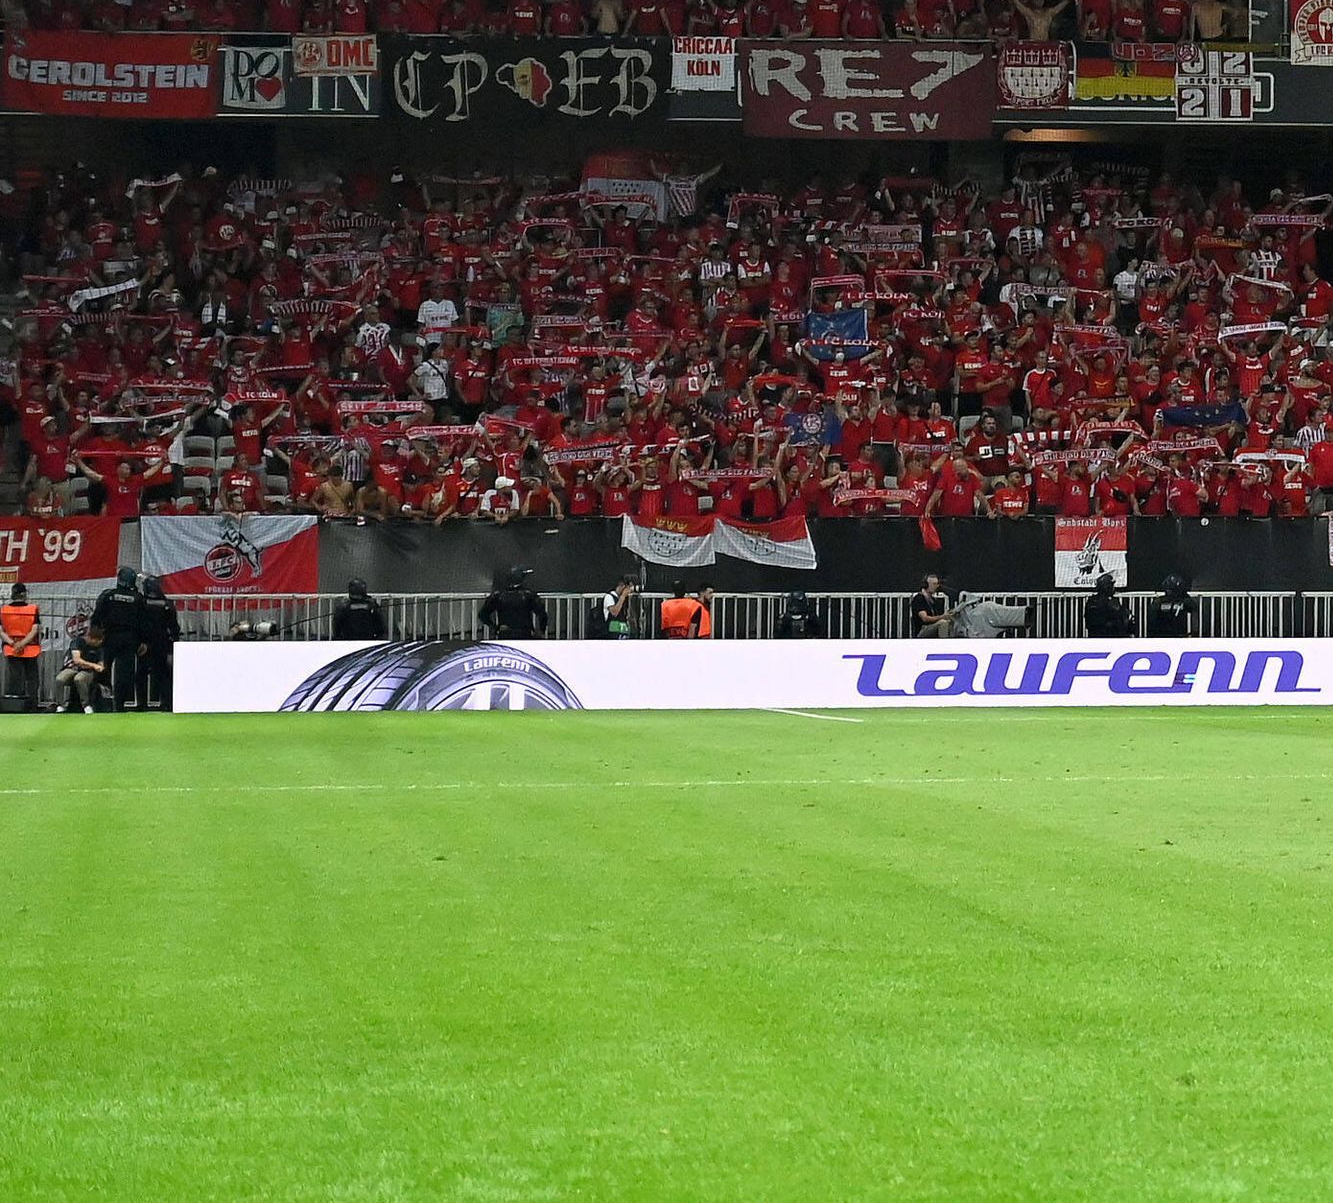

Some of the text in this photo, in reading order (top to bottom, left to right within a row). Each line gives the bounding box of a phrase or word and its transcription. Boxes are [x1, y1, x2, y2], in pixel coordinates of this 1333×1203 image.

[8, 54, 210, 89] GEROLSTEIN
[686, 56, 721, 78] KÖLN
[62, 89, 149, 105] SINCE 2012
[788, 110, 942, 133] CREW
[874, 291, 911, 301] KÖLN
[844, 338, 880, 348] KÖLN
[463, 656, 531, 673] Laufenn
[842, 650, 1320, 697] Laufenn
